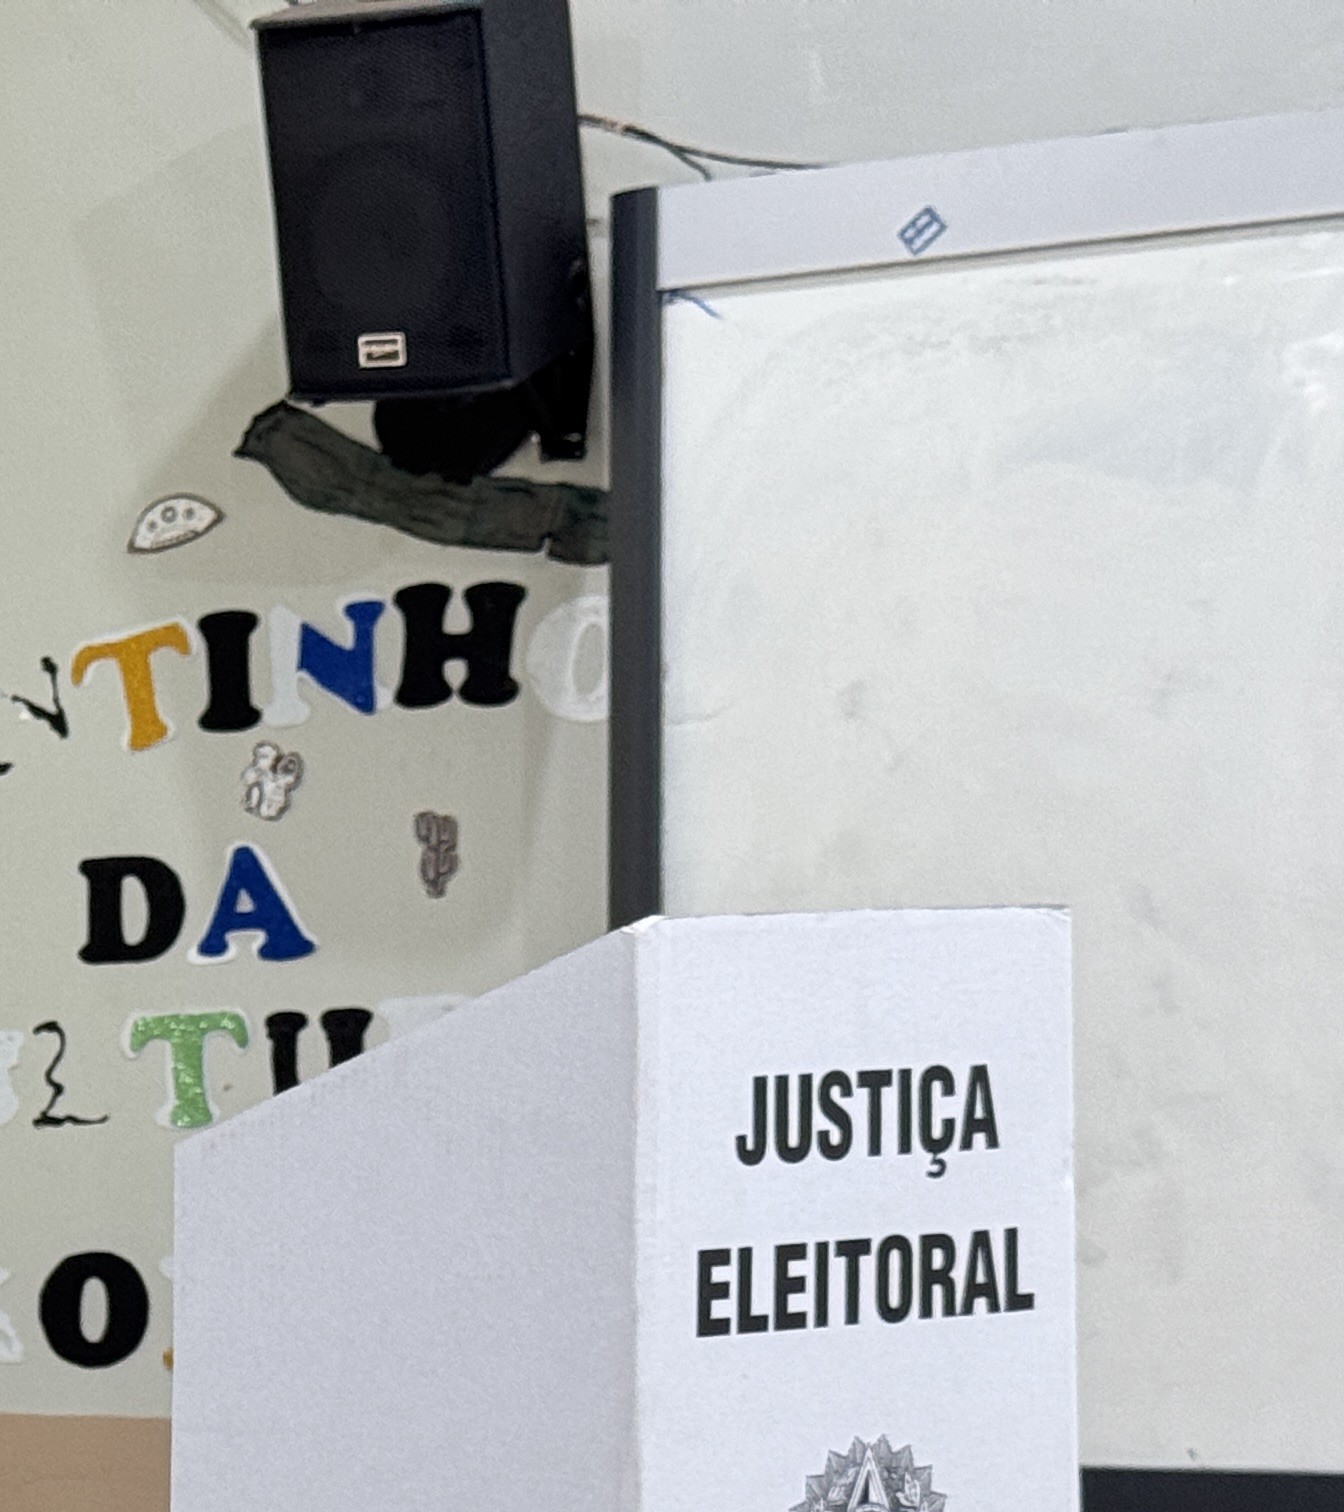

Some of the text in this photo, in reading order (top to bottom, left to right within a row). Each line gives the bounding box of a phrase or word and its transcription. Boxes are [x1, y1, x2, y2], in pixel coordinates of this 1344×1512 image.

[78, 846, 318, 964] DA
[735, 1063, 1000, 1179] JUSTIÇA
[695, 1226, 1035, 1338] ELEITORAL
